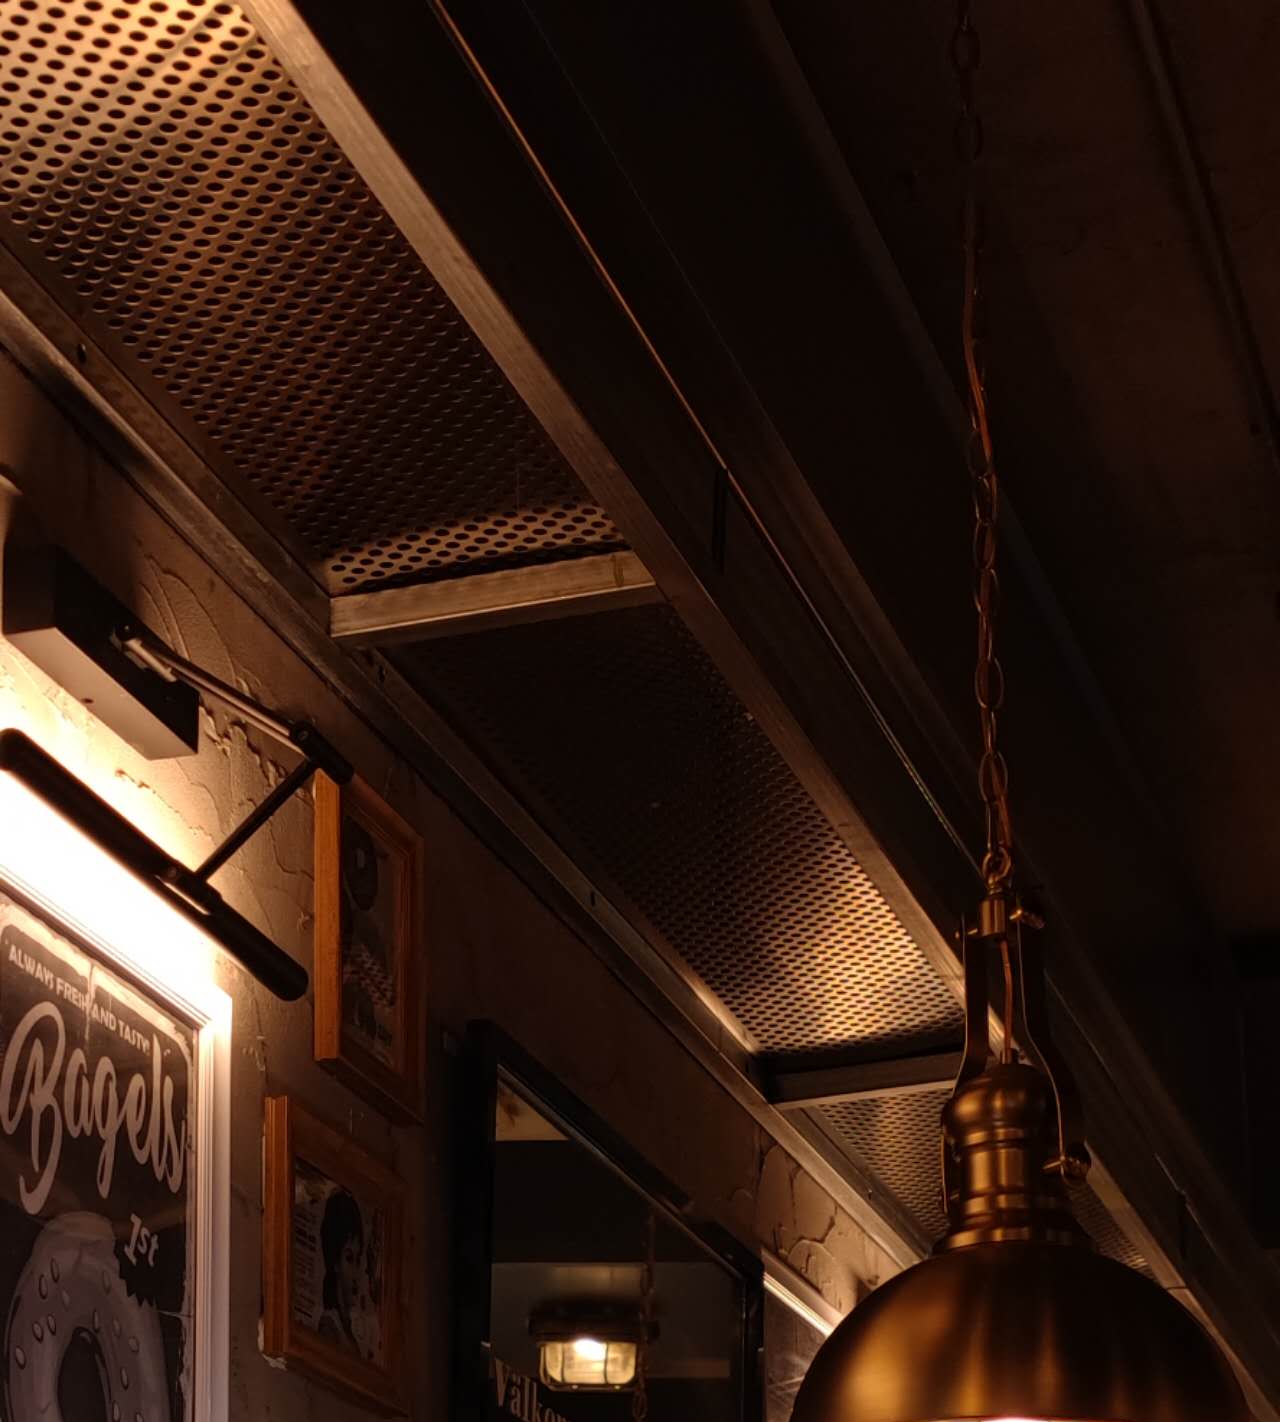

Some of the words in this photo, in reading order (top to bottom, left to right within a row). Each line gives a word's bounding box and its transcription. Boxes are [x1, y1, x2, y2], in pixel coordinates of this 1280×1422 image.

[9, 944, 54, 990] ALWAYS
[91, 1003, 117, 1031] AND
[1, 1001, 186, 1215] Bagels
[124, 1213, 160, 1267] 1st
